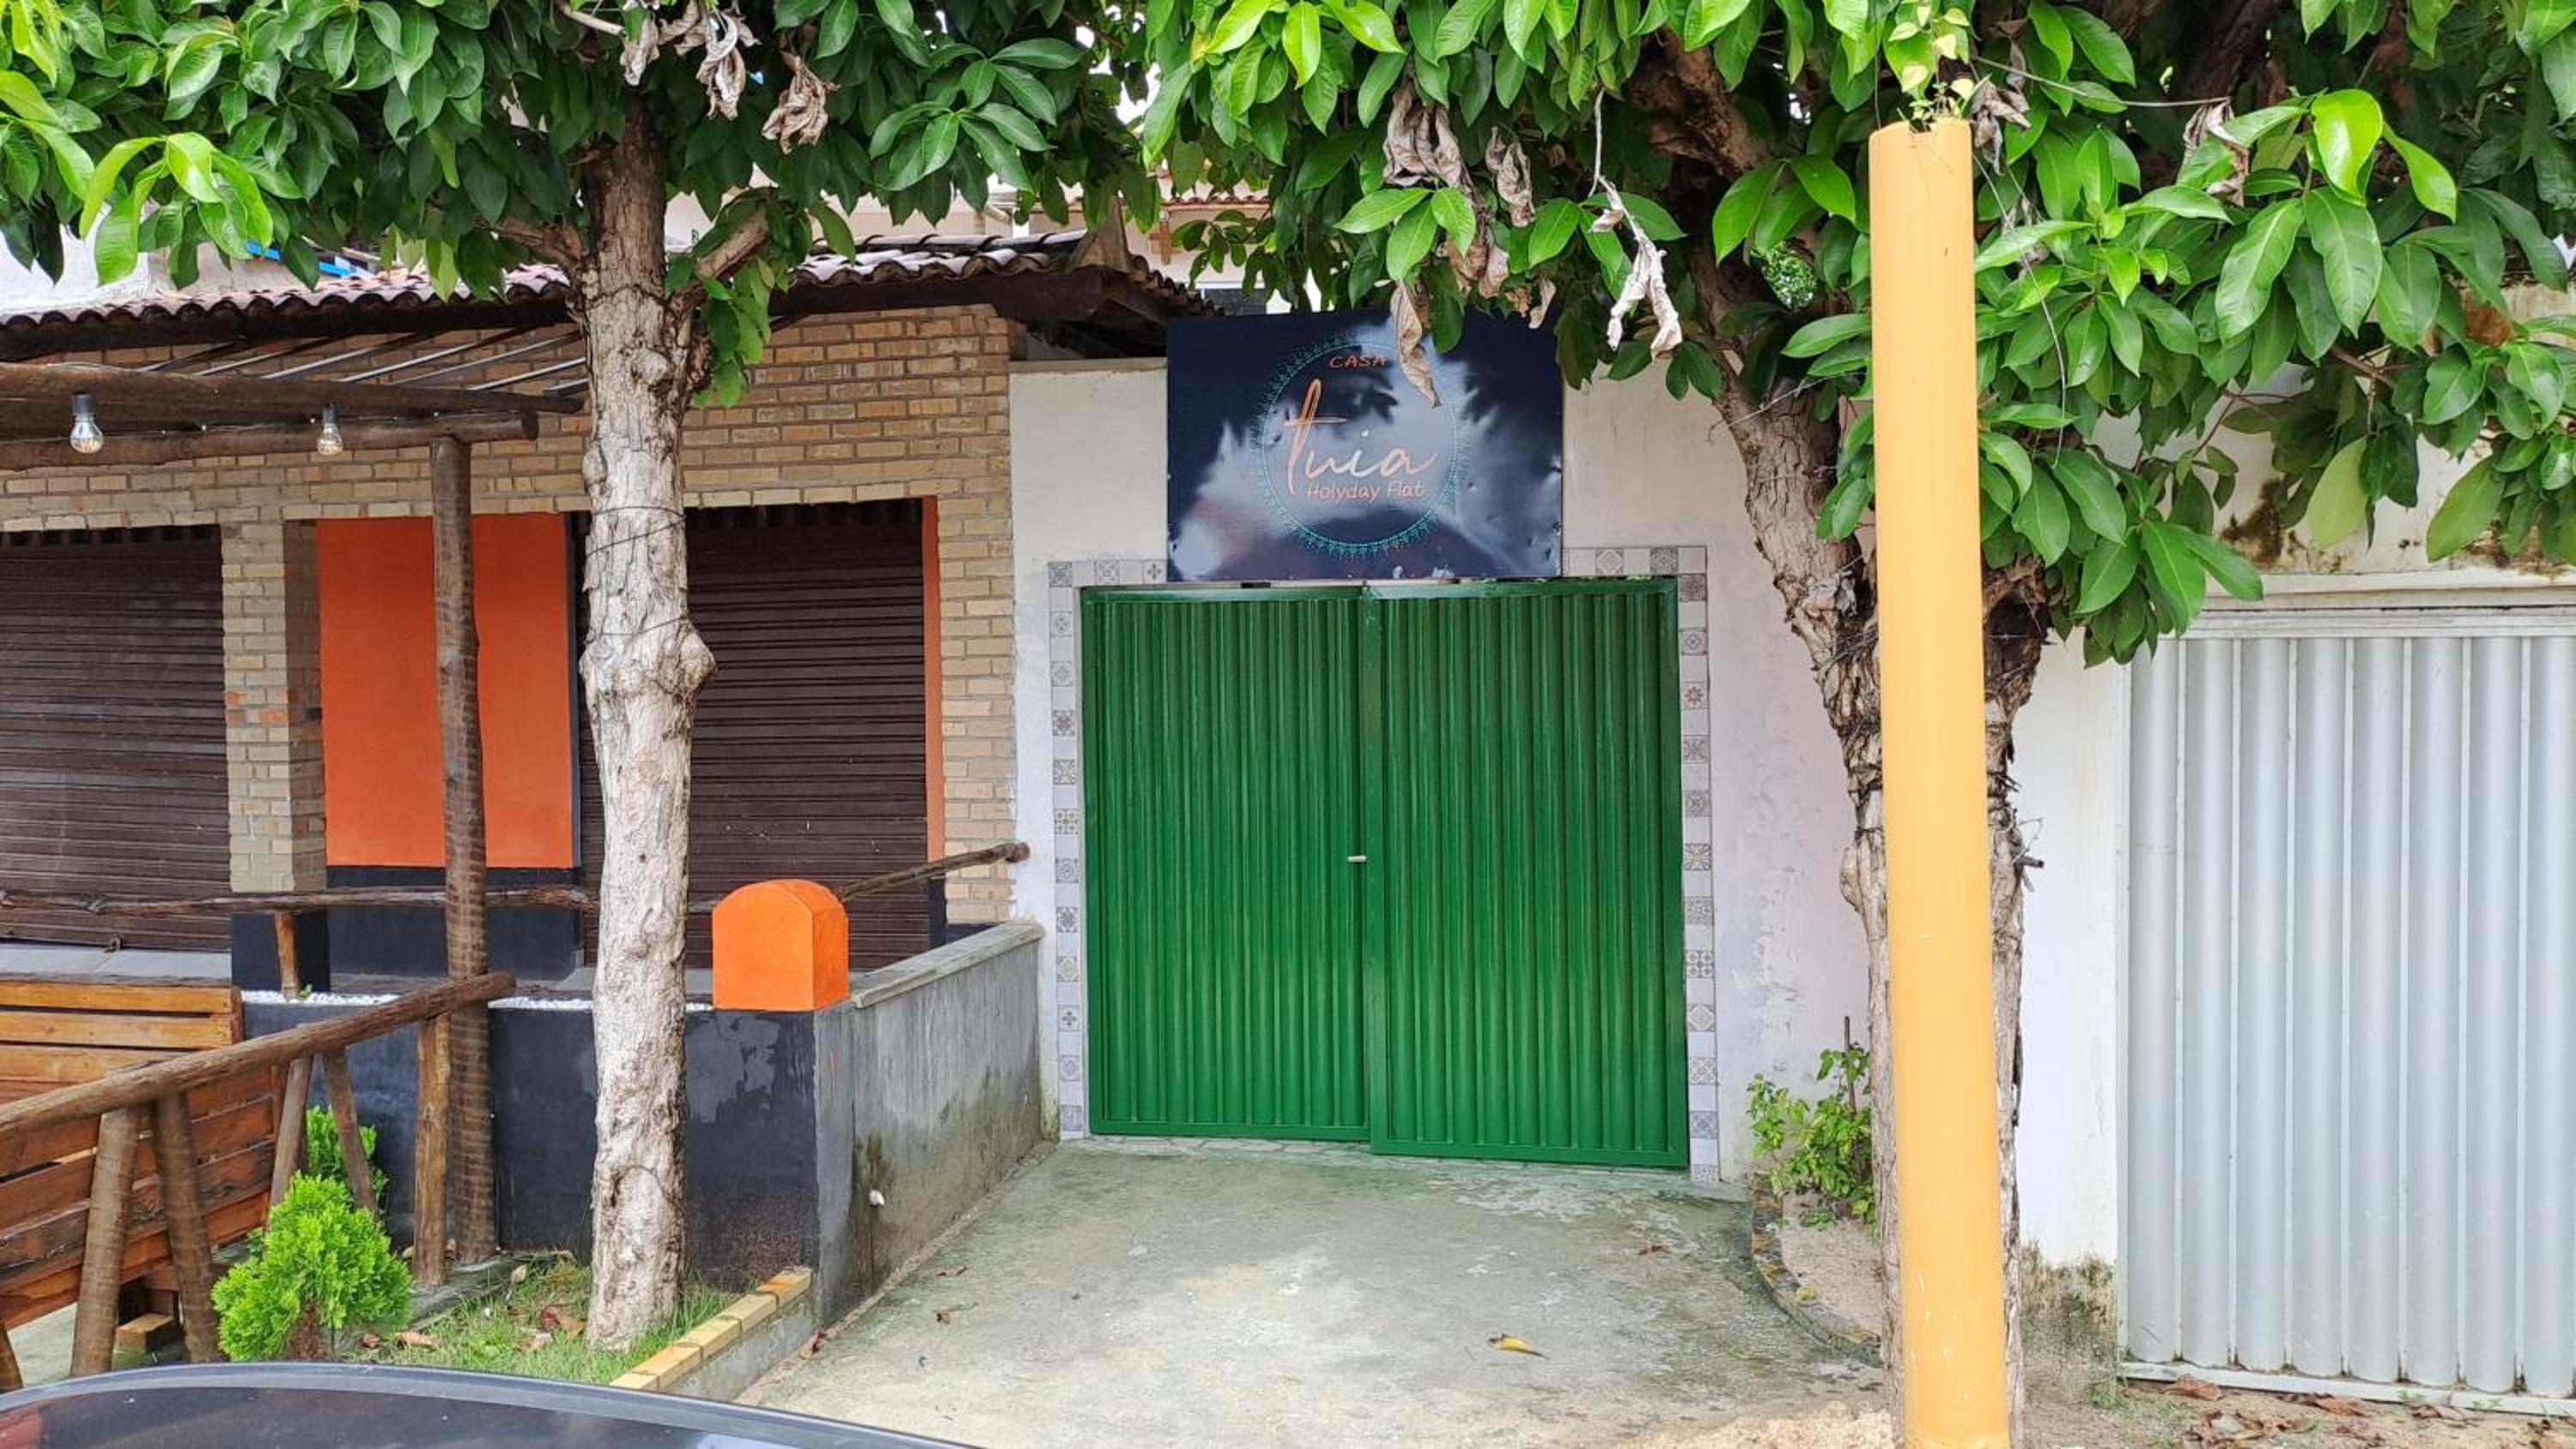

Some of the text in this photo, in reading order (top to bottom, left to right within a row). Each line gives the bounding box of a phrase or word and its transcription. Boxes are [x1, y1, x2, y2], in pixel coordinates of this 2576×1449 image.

[1329, 355, 1388, 369] CASA
[1306, 480, 1425, 502] Holyday Flat
